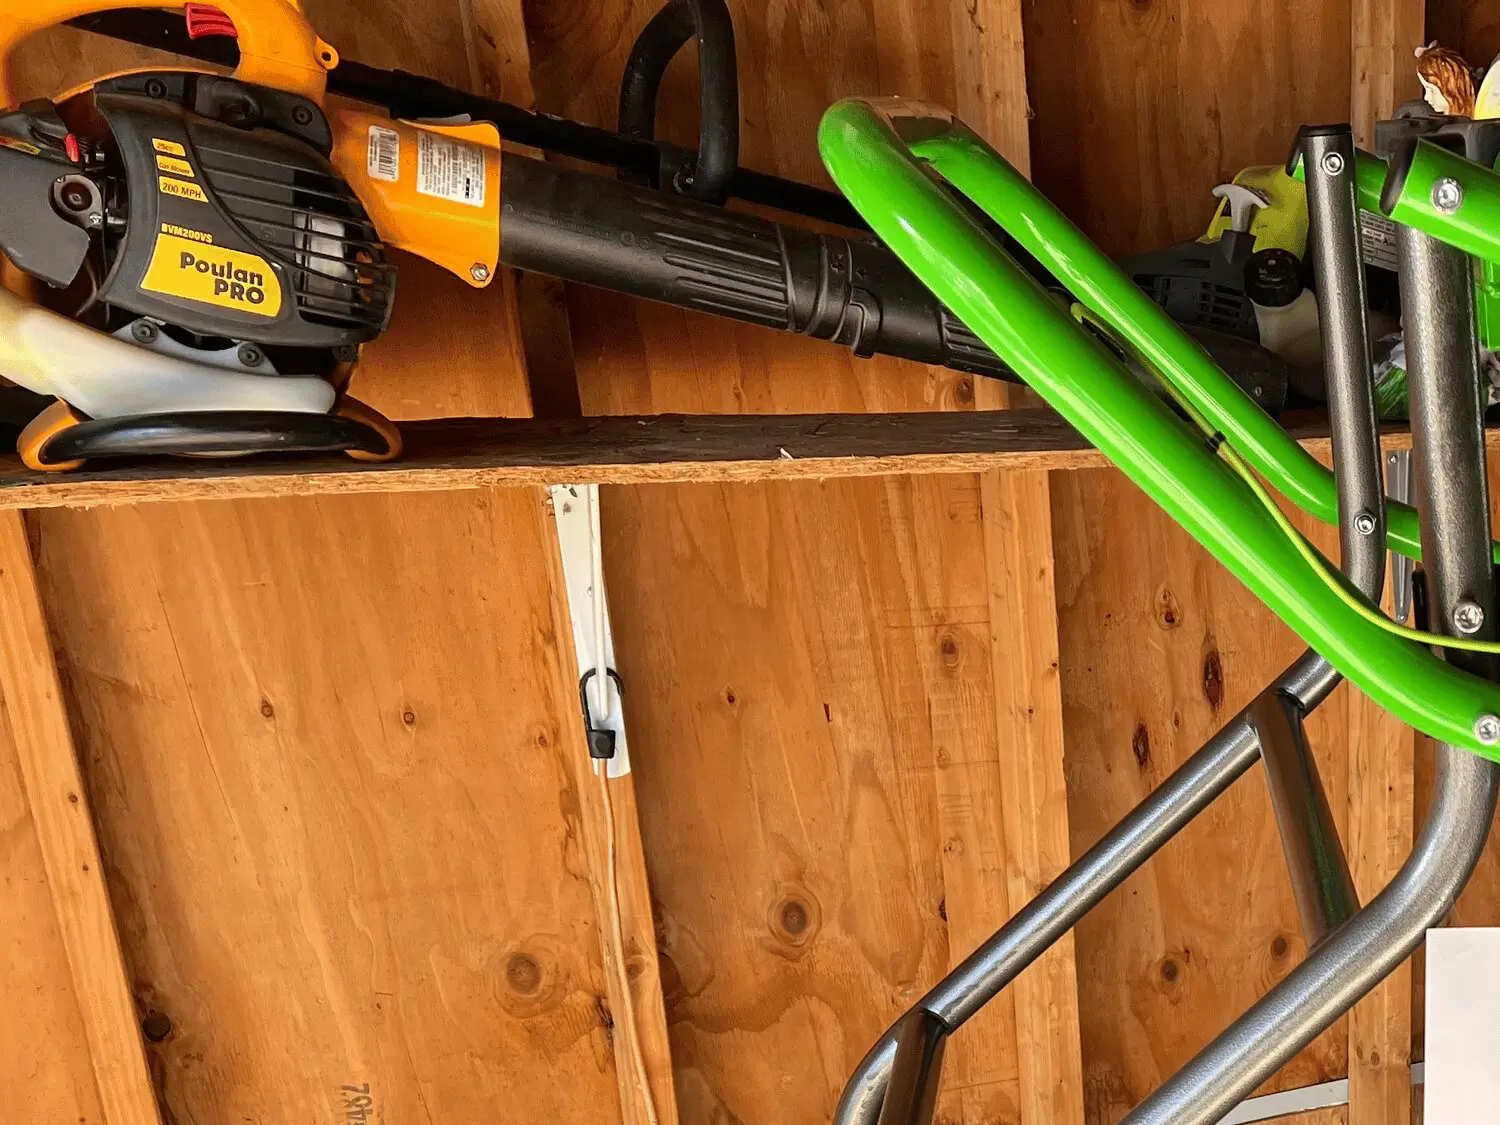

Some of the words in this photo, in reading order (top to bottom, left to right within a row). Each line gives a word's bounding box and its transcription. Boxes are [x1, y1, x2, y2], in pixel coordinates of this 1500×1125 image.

[162, 182, 179, 194] 200
[181, 187, 202, 199] MPH
[161, 222, 213, 244] BVM200VS
[180, 251, 264, 286] Poulan
[214, 278, 265, 304] PRO
